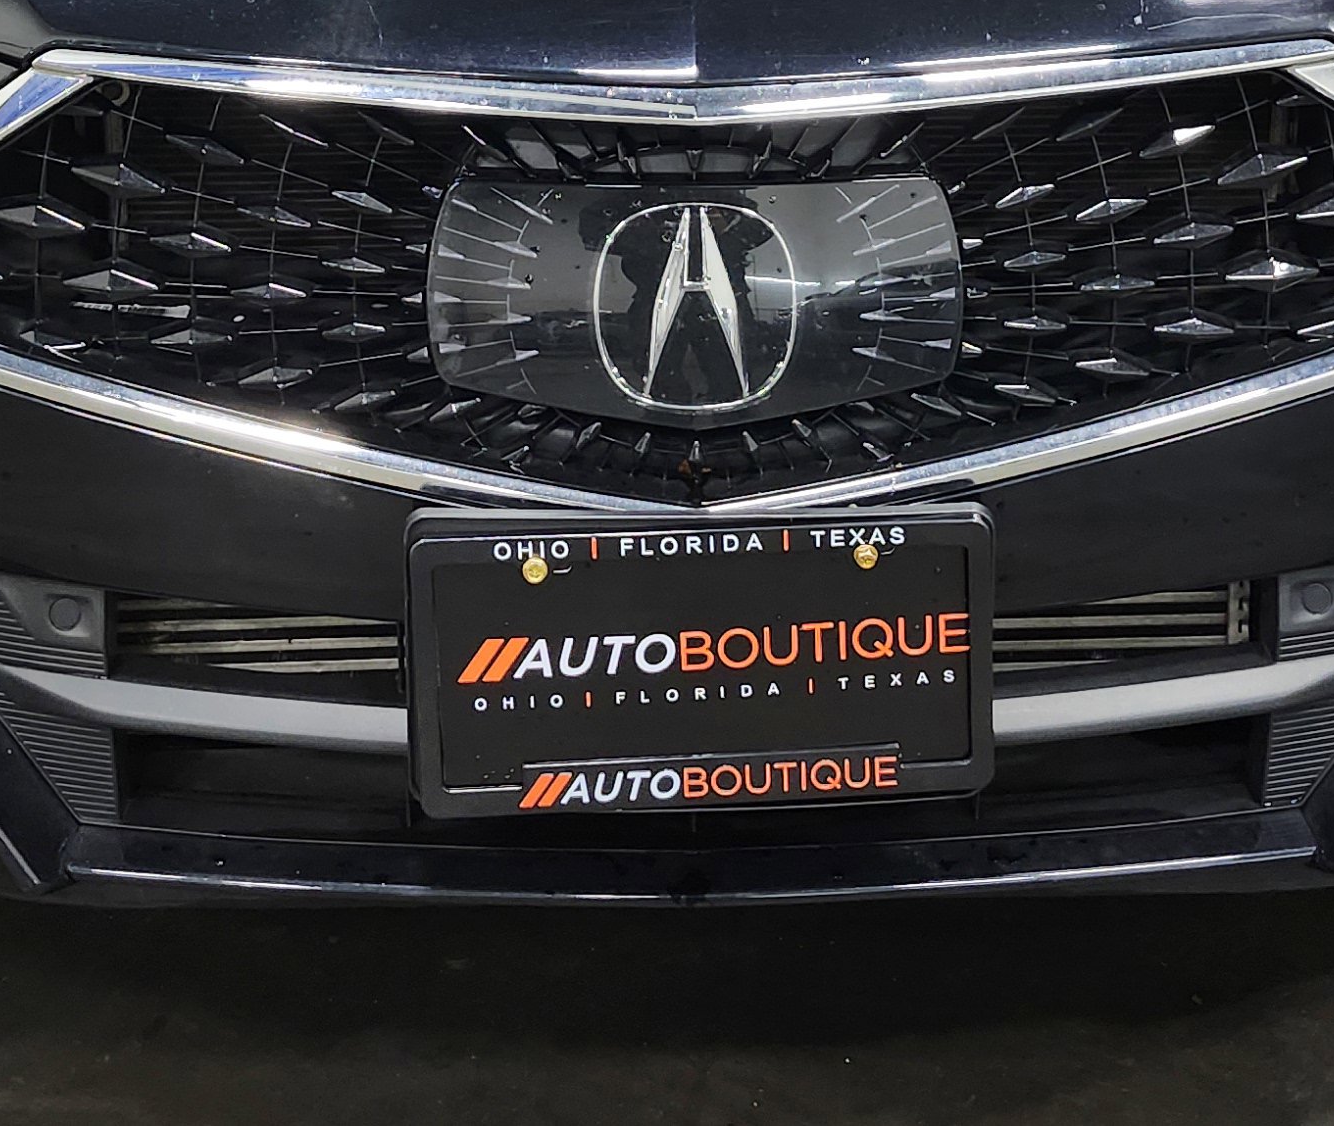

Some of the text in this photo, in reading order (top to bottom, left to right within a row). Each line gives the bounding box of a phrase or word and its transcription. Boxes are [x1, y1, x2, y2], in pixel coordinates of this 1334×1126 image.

[494, 526, 906, 561] OHIO FLORIDA TEXAS
[474, 669, 956, 711] OHIO FLORIDA TEXAS
